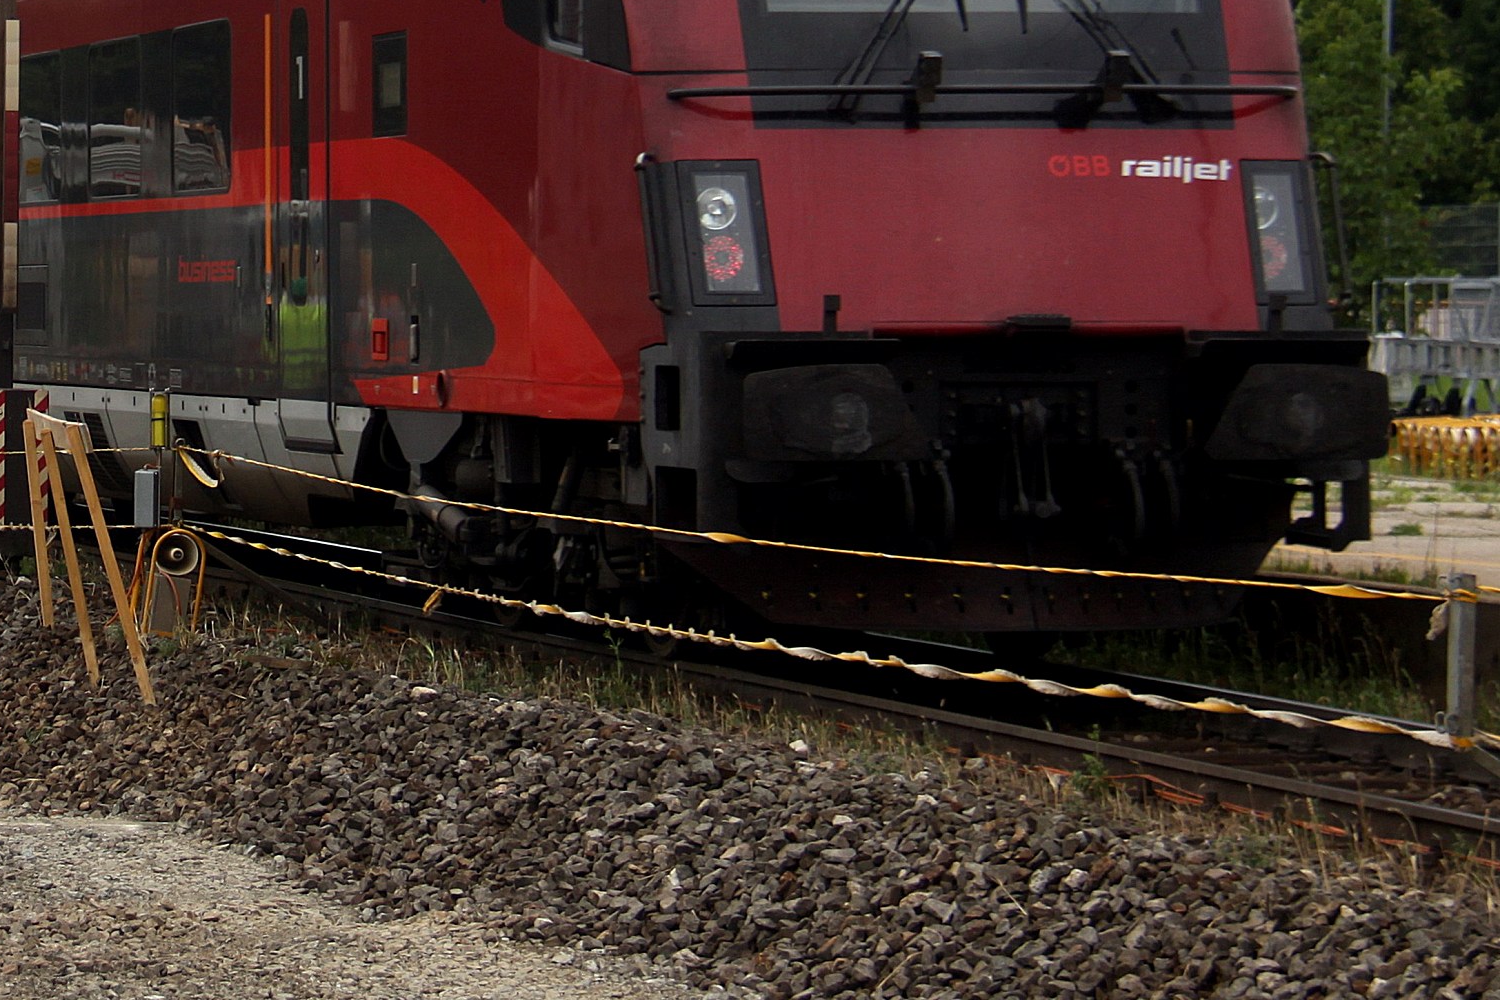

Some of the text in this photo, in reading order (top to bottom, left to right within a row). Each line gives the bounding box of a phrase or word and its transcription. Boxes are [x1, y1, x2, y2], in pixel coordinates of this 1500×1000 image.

[295, 55, 303, 99] 1
[1049, 154, 1232, 184] ÖBB railjet
[178, 254, 237, 283] business
